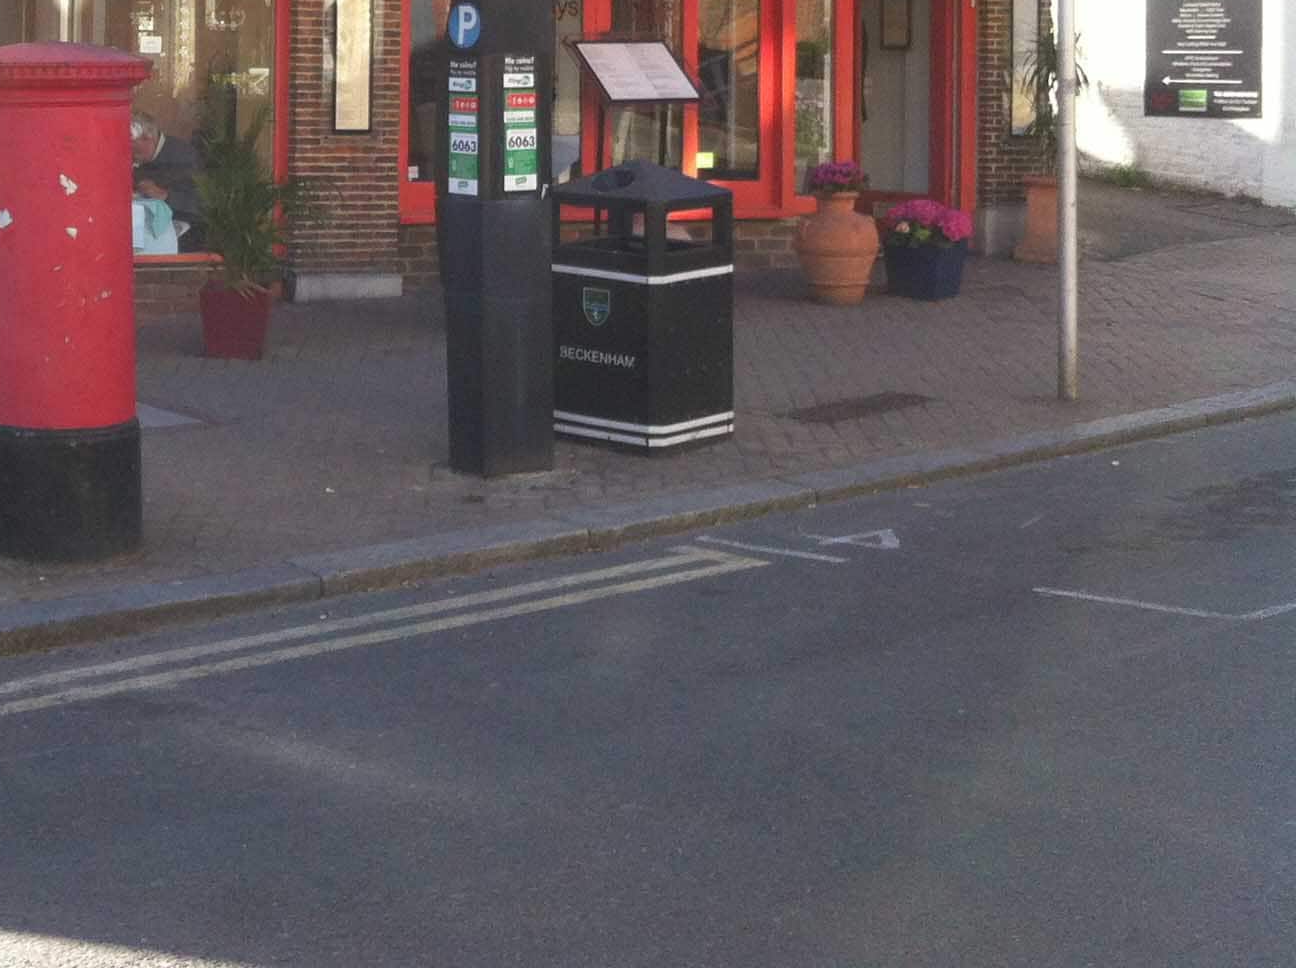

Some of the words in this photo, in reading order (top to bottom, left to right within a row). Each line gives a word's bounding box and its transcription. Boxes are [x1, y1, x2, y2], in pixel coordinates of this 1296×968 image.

[457, 4, 478, 46] P
[451, 139, 478, 153] 6063
[508, 135, 536, 149] 6063
[559, 344, 636, 369] BECKENHAM
